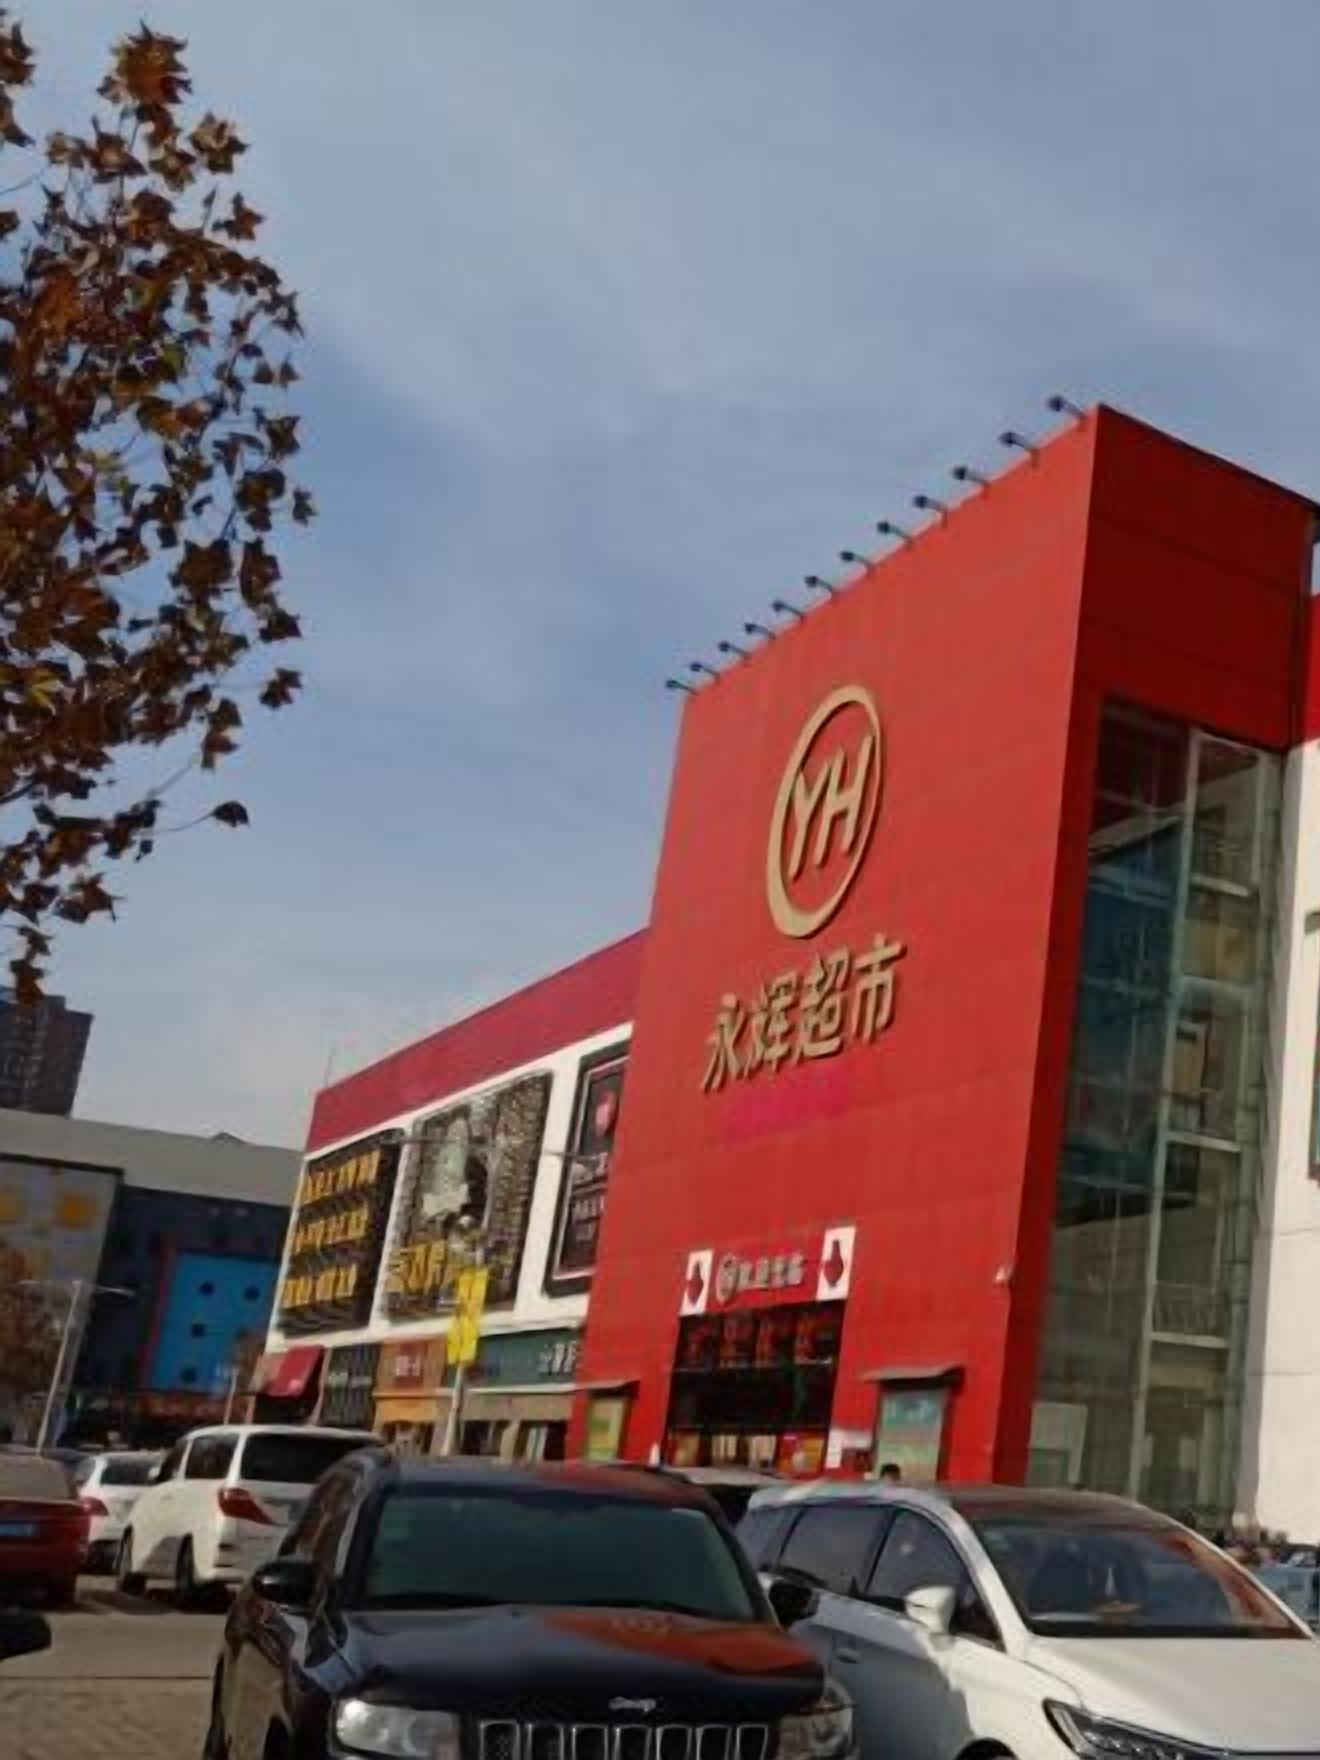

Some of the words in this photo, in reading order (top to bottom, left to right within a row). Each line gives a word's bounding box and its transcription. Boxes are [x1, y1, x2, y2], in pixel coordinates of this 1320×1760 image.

[788, 733, 876, 884] YH
[702, 933, 906, 1093] 永辉超市
